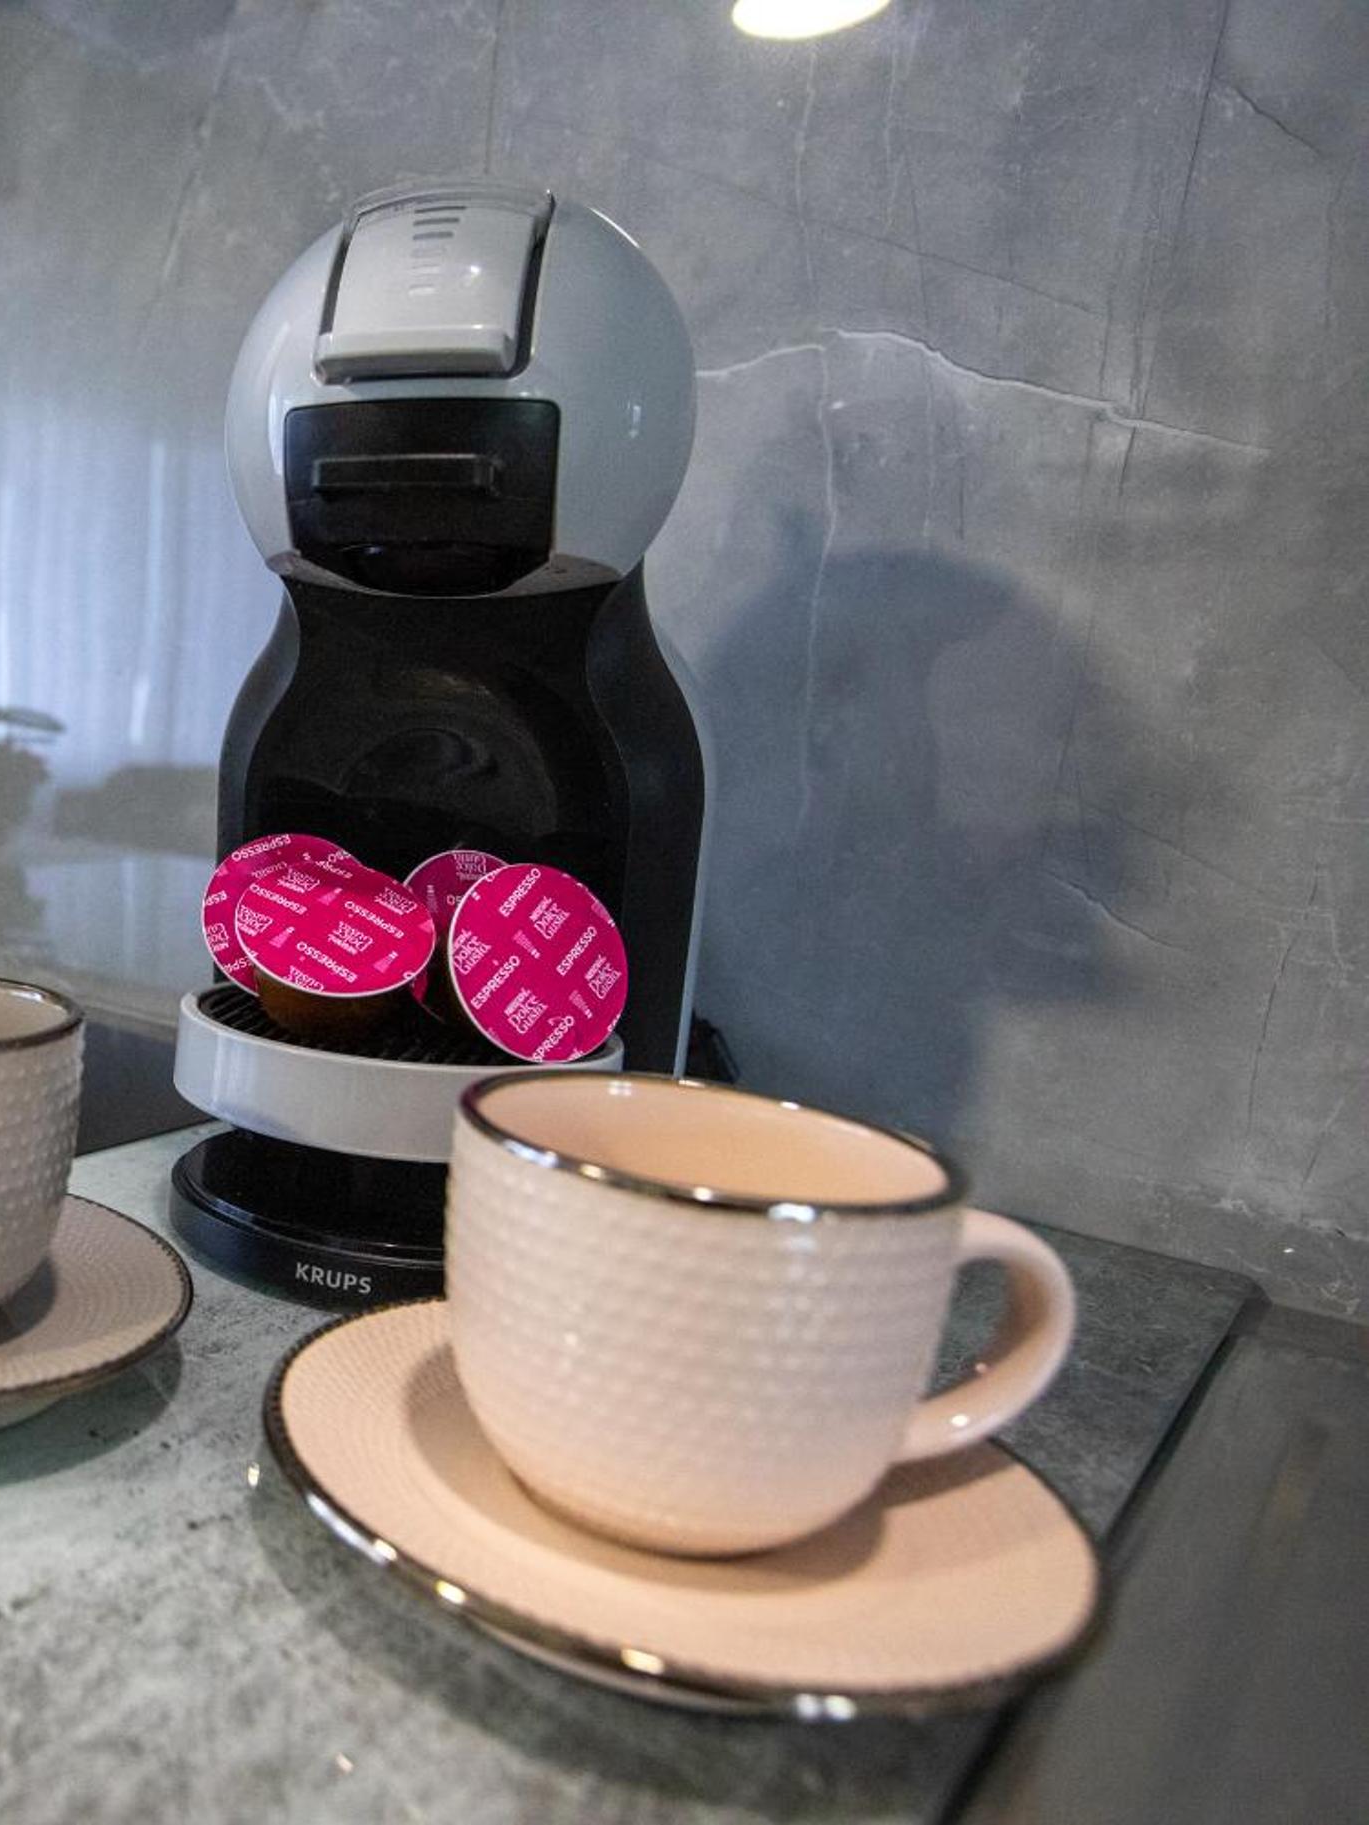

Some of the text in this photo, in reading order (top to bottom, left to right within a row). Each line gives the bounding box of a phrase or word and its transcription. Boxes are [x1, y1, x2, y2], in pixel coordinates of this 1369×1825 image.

[231, 834, 290, 861] ESPRESSO
[250, 884, 306, 914] ESPRESSO
[499, 868, 540, 916] ESPRESSO
[345, 901, 403, 938] ESPRESSO
[297, 942, 356, 982] ESPRESSO
[557, 927, 596, 975] ESPRESSO
[471, 956, 519, 1008] ESPRESSO
[508, 996, 538, 1027] Dolce
[295, 1262, 372, 1294] KRUPS
